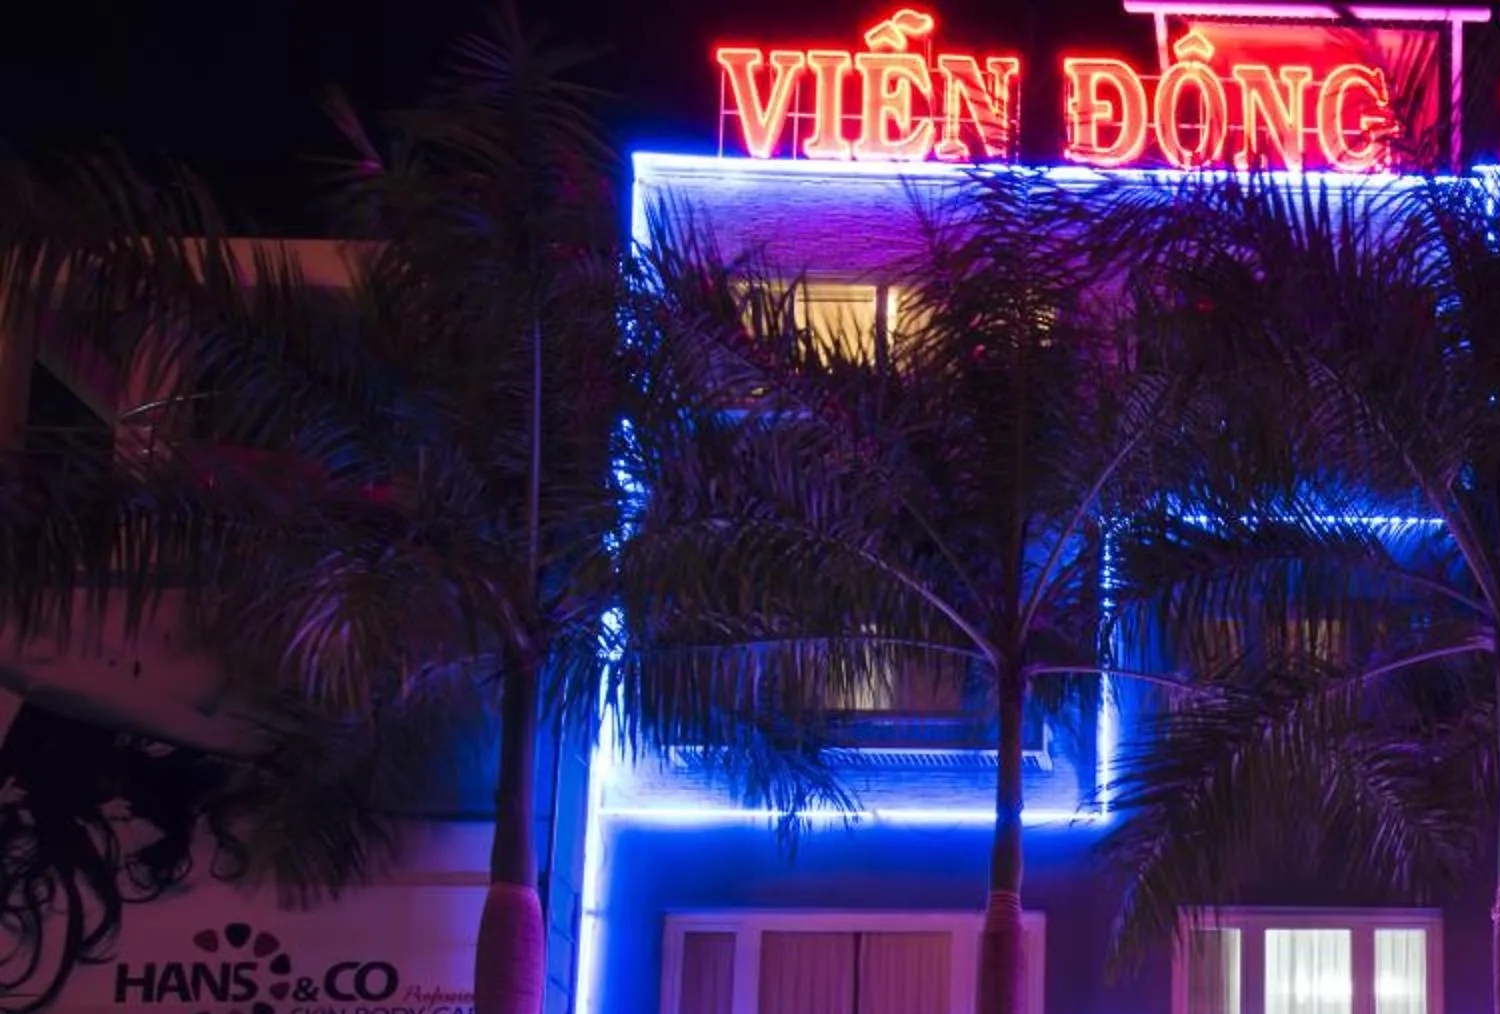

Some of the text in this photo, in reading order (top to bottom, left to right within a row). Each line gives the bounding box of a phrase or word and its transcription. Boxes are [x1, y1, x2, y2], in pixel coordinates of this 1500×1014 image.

[717, 9, 1019, 160] VIỄN
[1063, 30, 1398, 173] ĐÔNG
[115, 961, 399, 1003] HANS &CO
